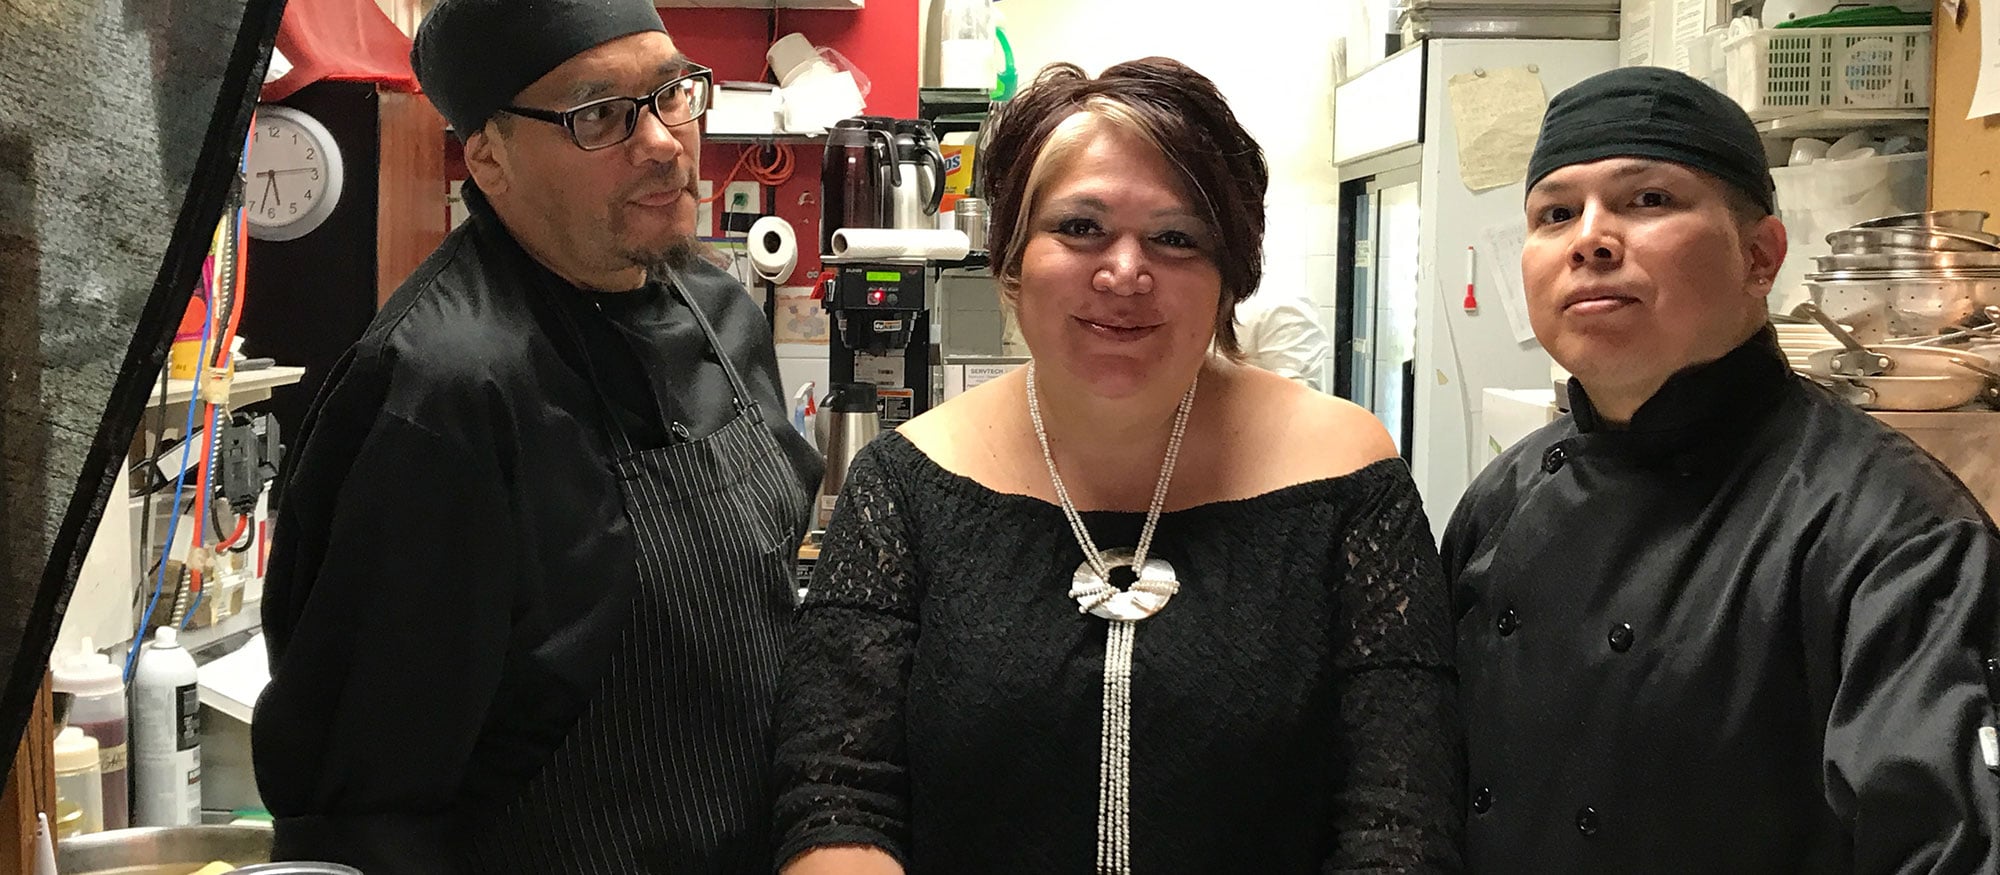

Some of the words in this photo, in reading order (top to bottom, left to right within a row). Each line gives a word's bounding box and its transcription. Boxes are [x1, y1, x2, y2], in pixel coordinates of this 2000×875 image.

[268, 127, 280, 138] 12
[292, 134, 298, 145] 1
[306, 148, 314, 160] 2
[311, 168, 319, 181] 3
[304, 190, 312, 201] 4
[249, 201, 256, 212] 7
[289, 202, 297, 214] 5
[268, 208, 275, 219] 6
